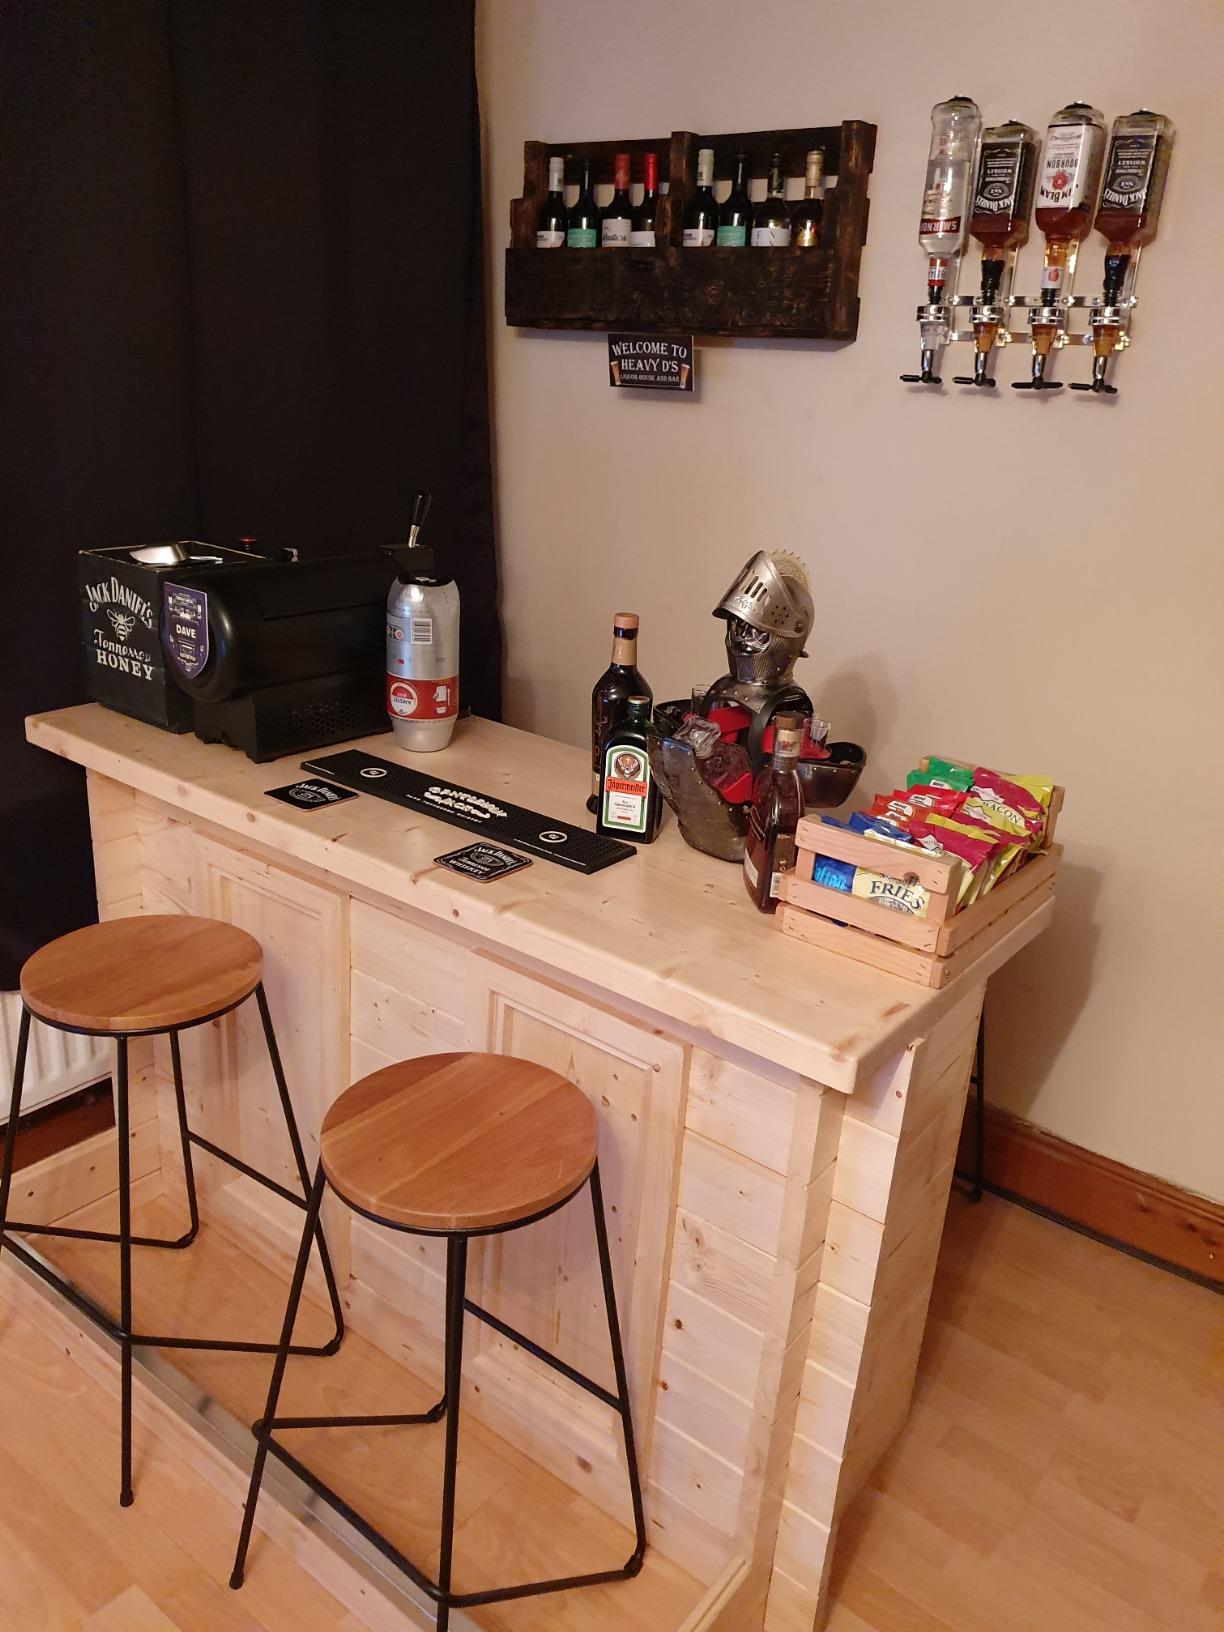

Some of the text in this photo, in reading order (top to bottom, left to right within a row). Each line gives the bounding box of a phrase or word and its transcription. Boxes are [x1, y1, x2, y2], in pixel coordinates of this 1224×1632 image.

[1040, 185, 1061, 203] BEAM
[611, 341, 687, 359] WELCOME TO
[621, 358, 679, 373] HEAVY D'S
[85, 581, 110, 613] JACK
[110, 576, 153, 629] DANIEL'S
[175, 624, 197, 639] DAVE
[95, 649, 154, 681] HONEY
[870, 880, 926, 910] FRIES
